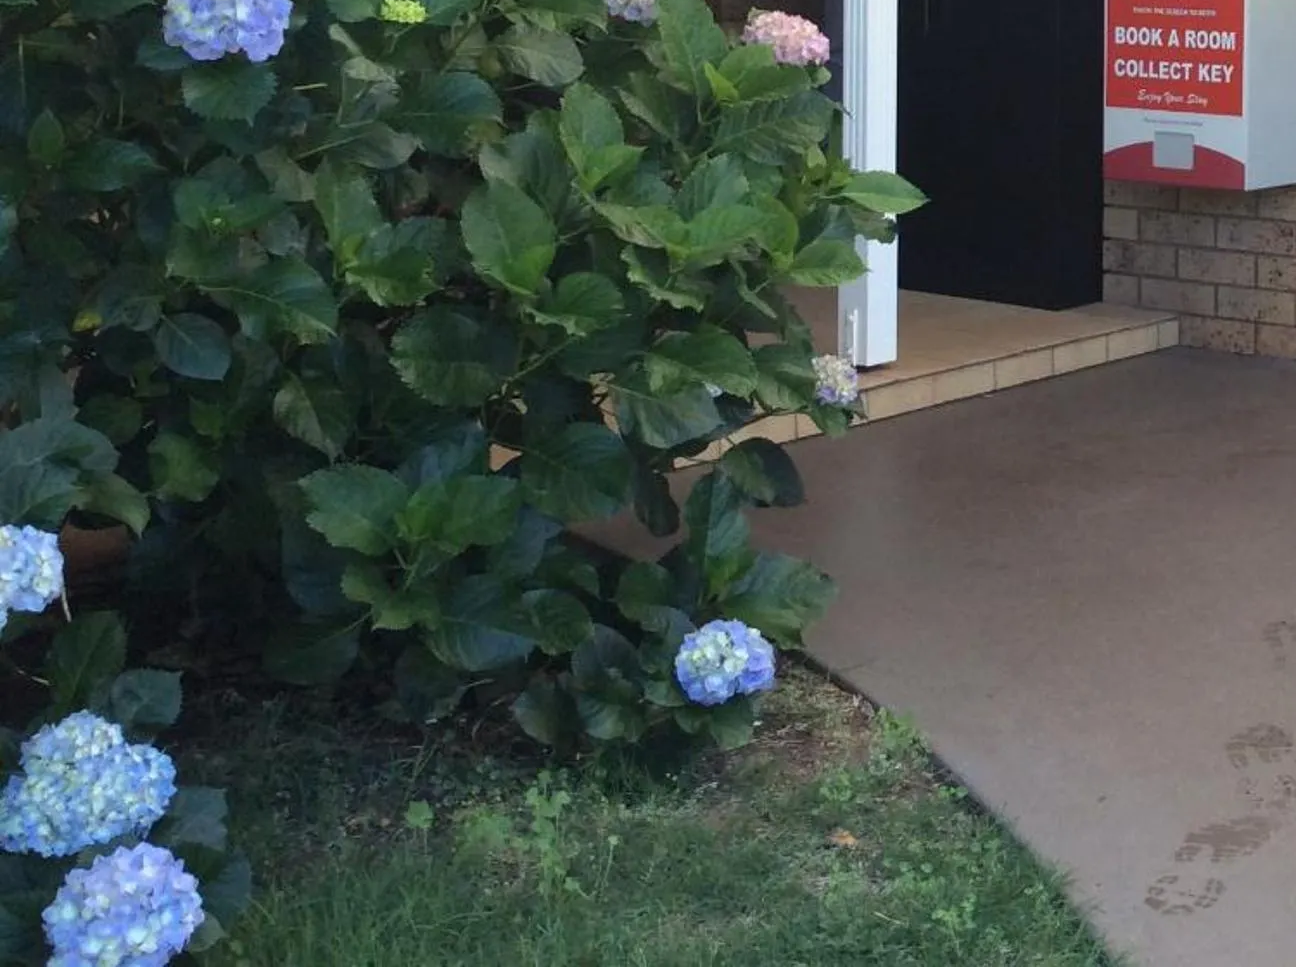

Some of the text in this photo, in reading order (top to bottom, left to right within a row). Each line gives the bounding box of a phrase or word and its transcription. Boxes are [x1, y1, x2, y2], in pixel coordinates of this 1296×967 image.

[1114, 26, 1236, 51] BOOK A ROOM
[1114, 59, 1235, 84] COLLECT KEY
